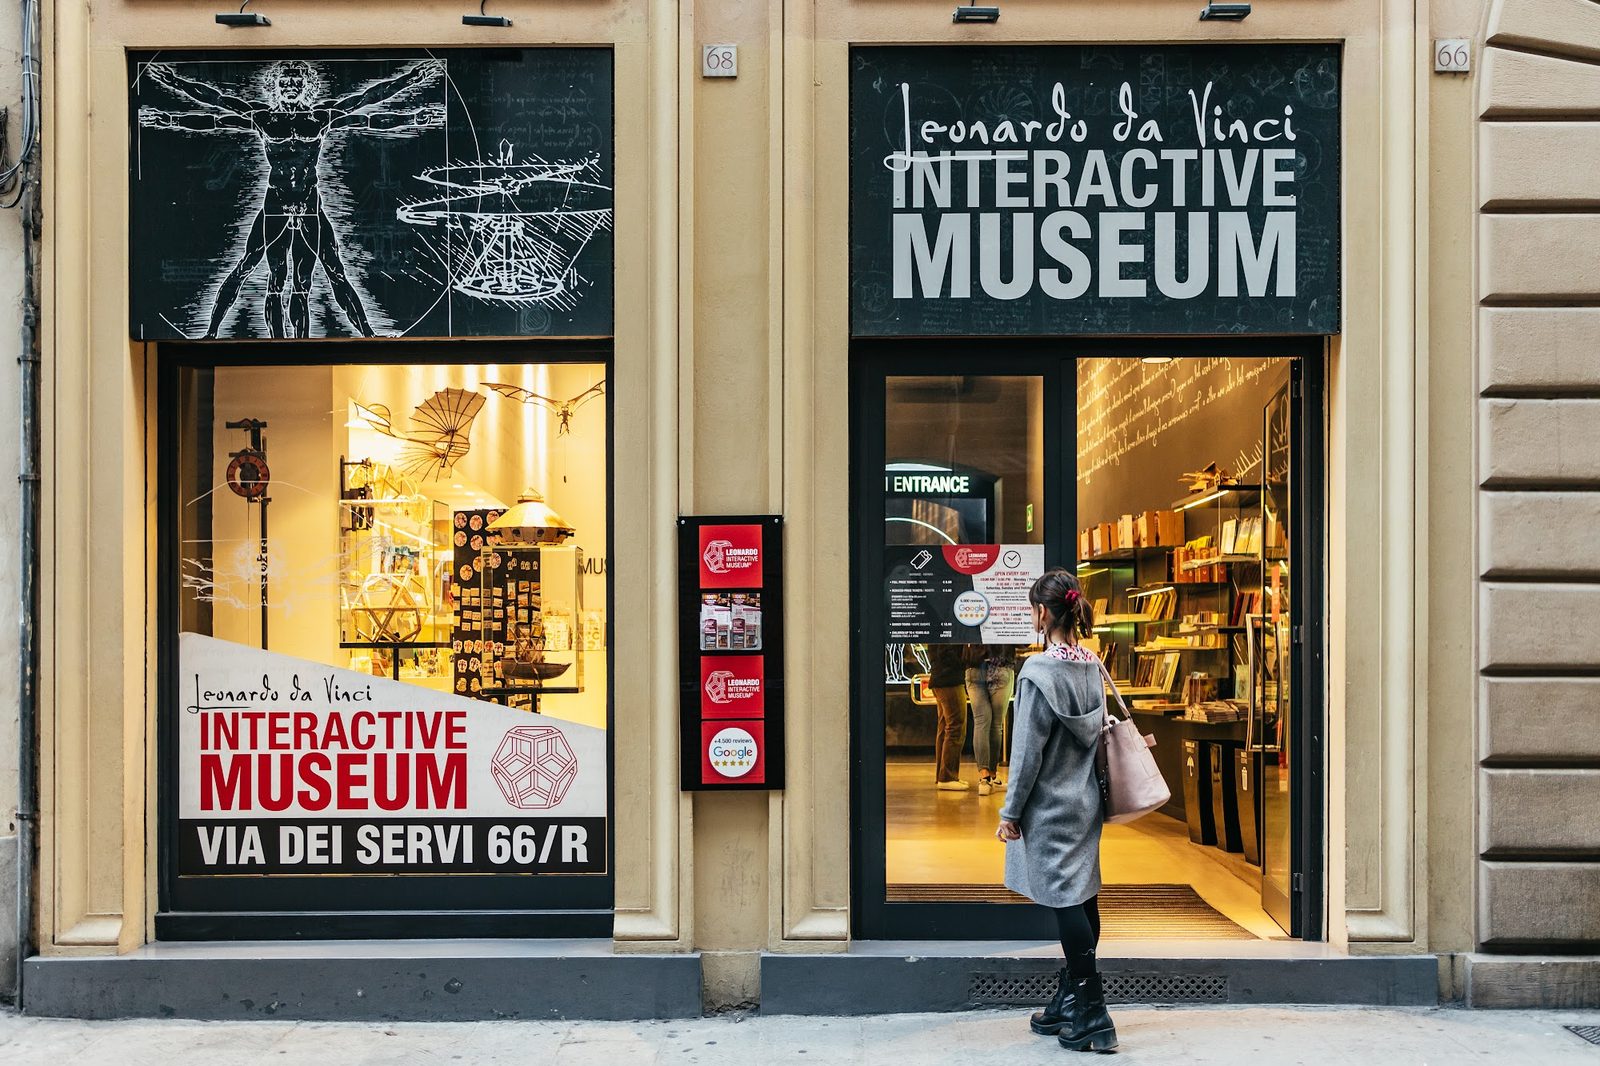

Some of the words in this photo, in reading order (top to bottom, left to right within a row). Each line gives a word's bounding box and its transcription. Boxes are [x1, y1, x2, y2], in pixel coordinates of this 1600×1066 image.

[707, 47, 733, 70] 68
[1438, 44, 1467, 67] 66
[884, 82, 1087, 171] Leonardo
[1113, 81, 1163, 142] da
[1188, 81, 1296, 148] Vinci
[893, 149, 1297, 208] INTERACTIVE
[892, 210, 1297, 299] MUSEUM
[894, 476, 969, 493] ENTRANCE
[959, 604, 985, 613] Google
[187, 674, 279, 714] Leonardo
[290, 674, 312, 702] da
[323, 674, 373, 704] Vinci
[200, 711, 467, 750] INTERACTIVE
[713, 746, 752, 759] Google
[200, 753, 467, 812] MUSEUM
[197, 826, 266, 865] VIA
[279, 825, 342, 865] DEI
[356, 824, 473, 865] SERVI
[487, 824, 589, 864] 66/R
